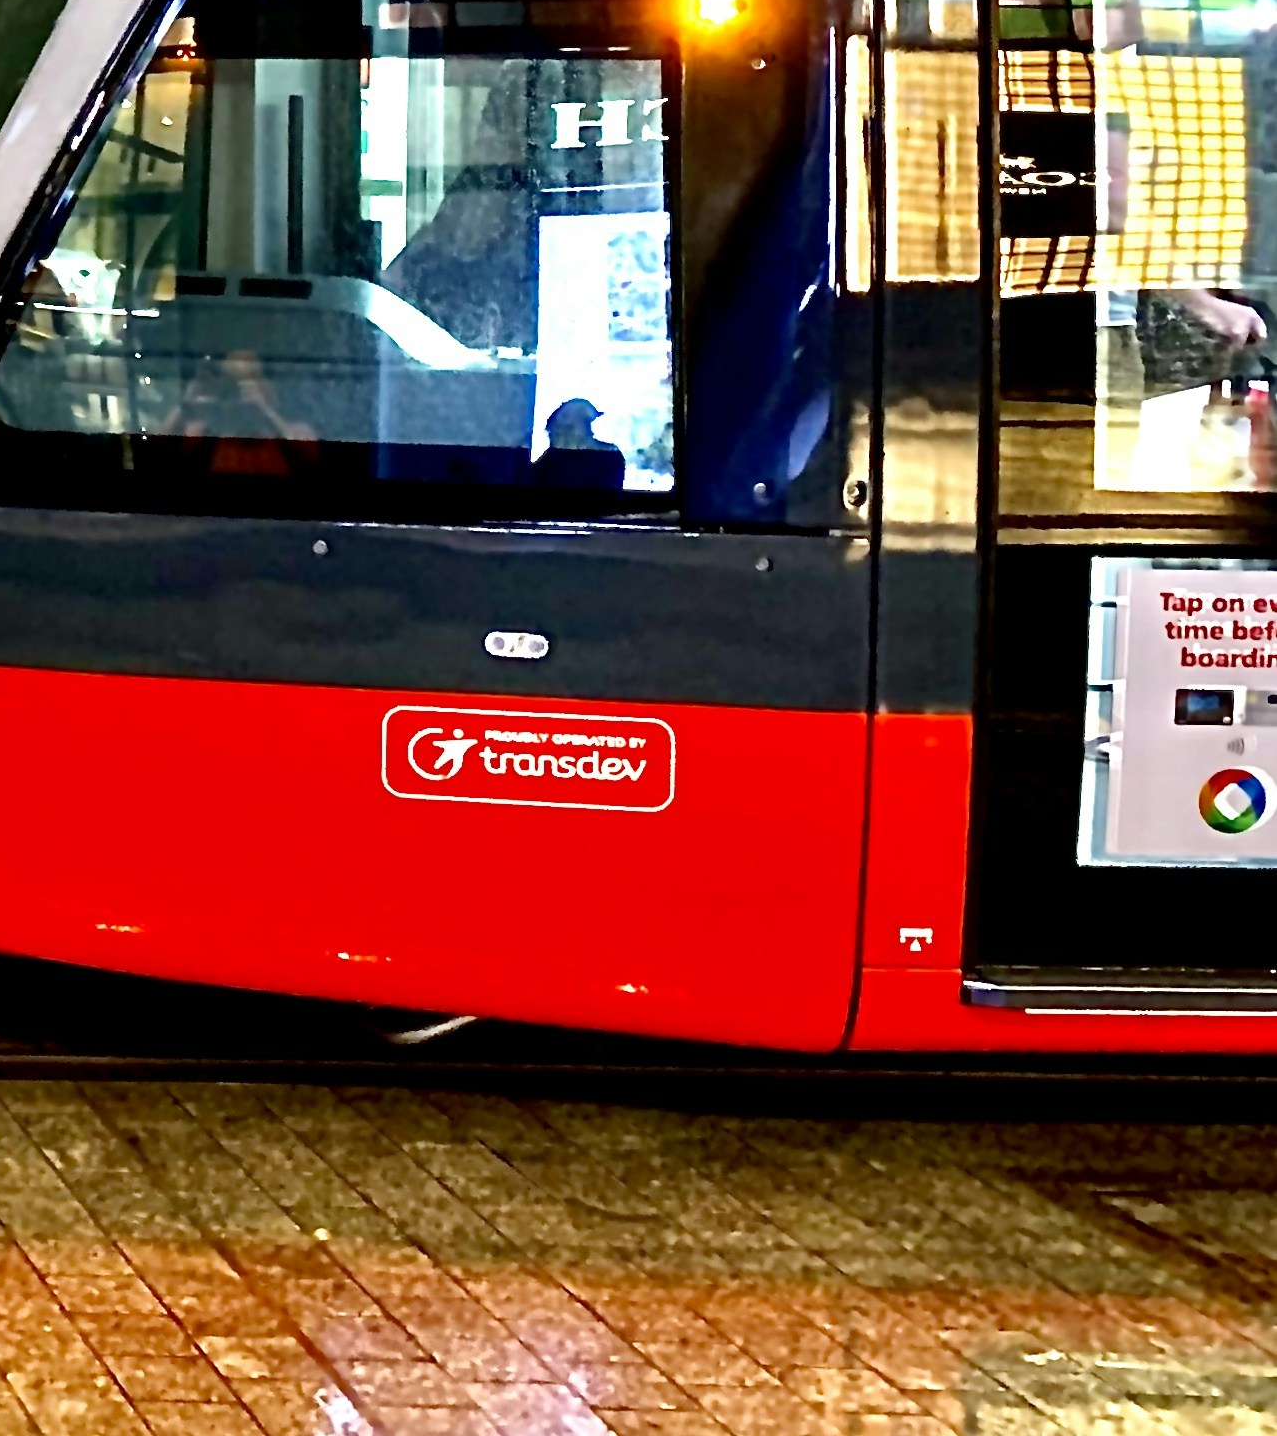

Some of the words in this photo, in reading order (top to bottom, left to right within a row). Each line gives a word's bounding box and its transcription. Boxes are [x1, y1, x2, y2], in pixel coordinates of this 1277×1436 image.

[1159, 592, 1203, 617] Tap
[1212, 597, 1245, 613] on
[1164, 619, 1224, 640] time
[484, 729, 549, 744] PROUDLY
[551, 732, 627, 749] OPERATED
[628, 737, 647, 749] BY
[478, 745, 647, 782] transdev
